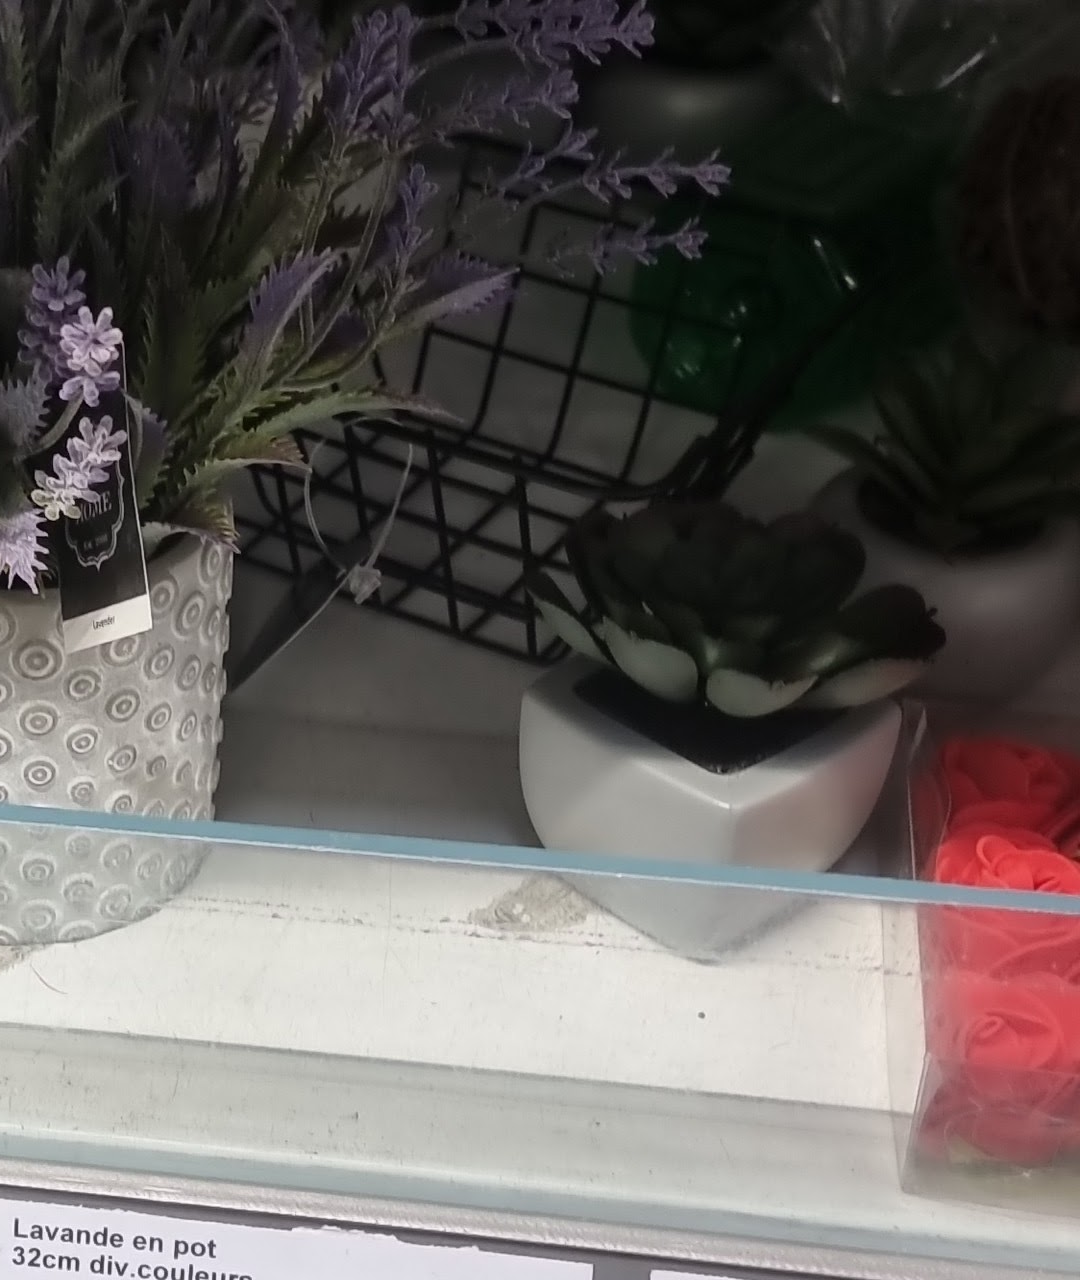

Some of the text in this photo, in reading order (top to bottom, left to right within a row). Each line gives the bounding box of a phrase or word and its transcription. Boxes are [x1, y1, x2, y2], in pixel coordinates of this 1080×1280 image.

[14, 1218, 216, 1260] Lavande en pot
[12, 1246, 80, 1272] 32cm
